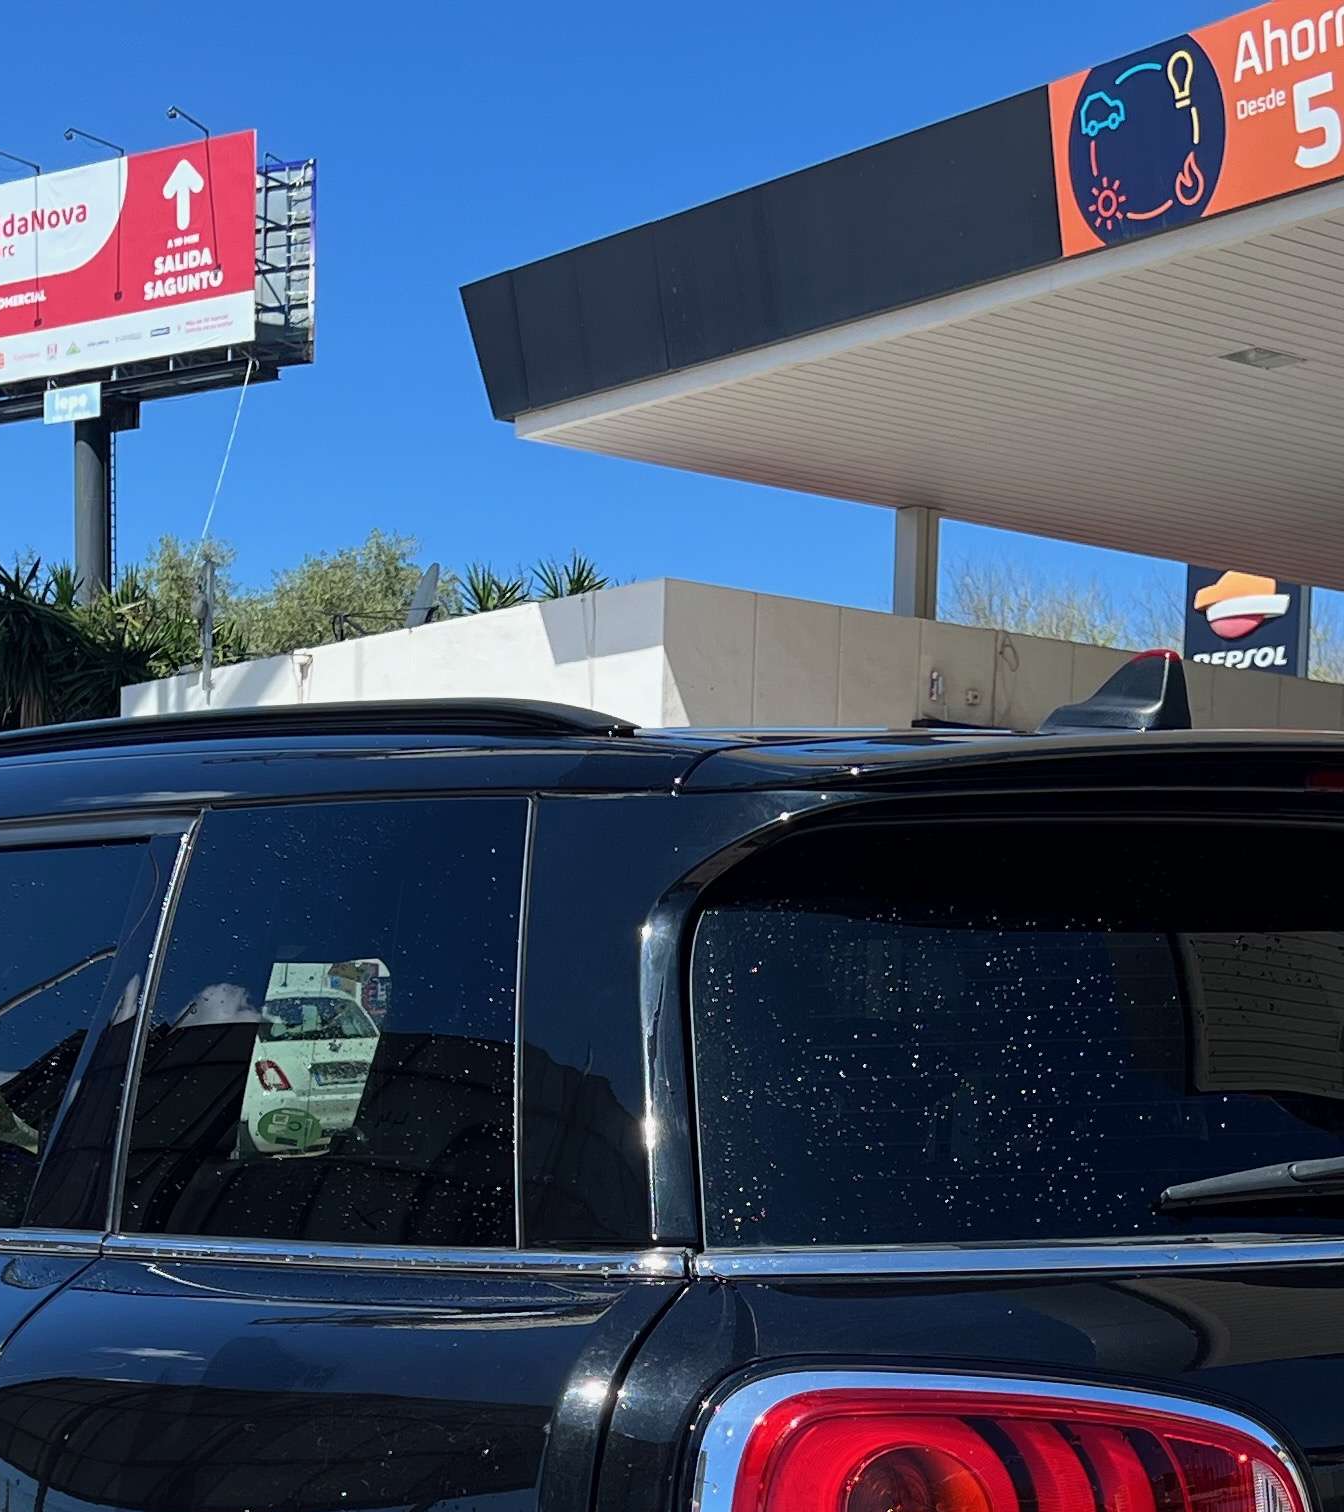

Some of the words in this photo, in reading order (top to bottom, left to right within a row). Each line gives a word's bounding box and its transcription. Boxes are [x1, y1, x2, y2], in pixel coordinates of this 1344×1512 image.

[1236, 88, 1286, 121] Desde
[1291, 72, 1342, 169] 5
[154, 247, 213, 276] SALIDA
[143, 269, 223, 301] SAGUNTO
